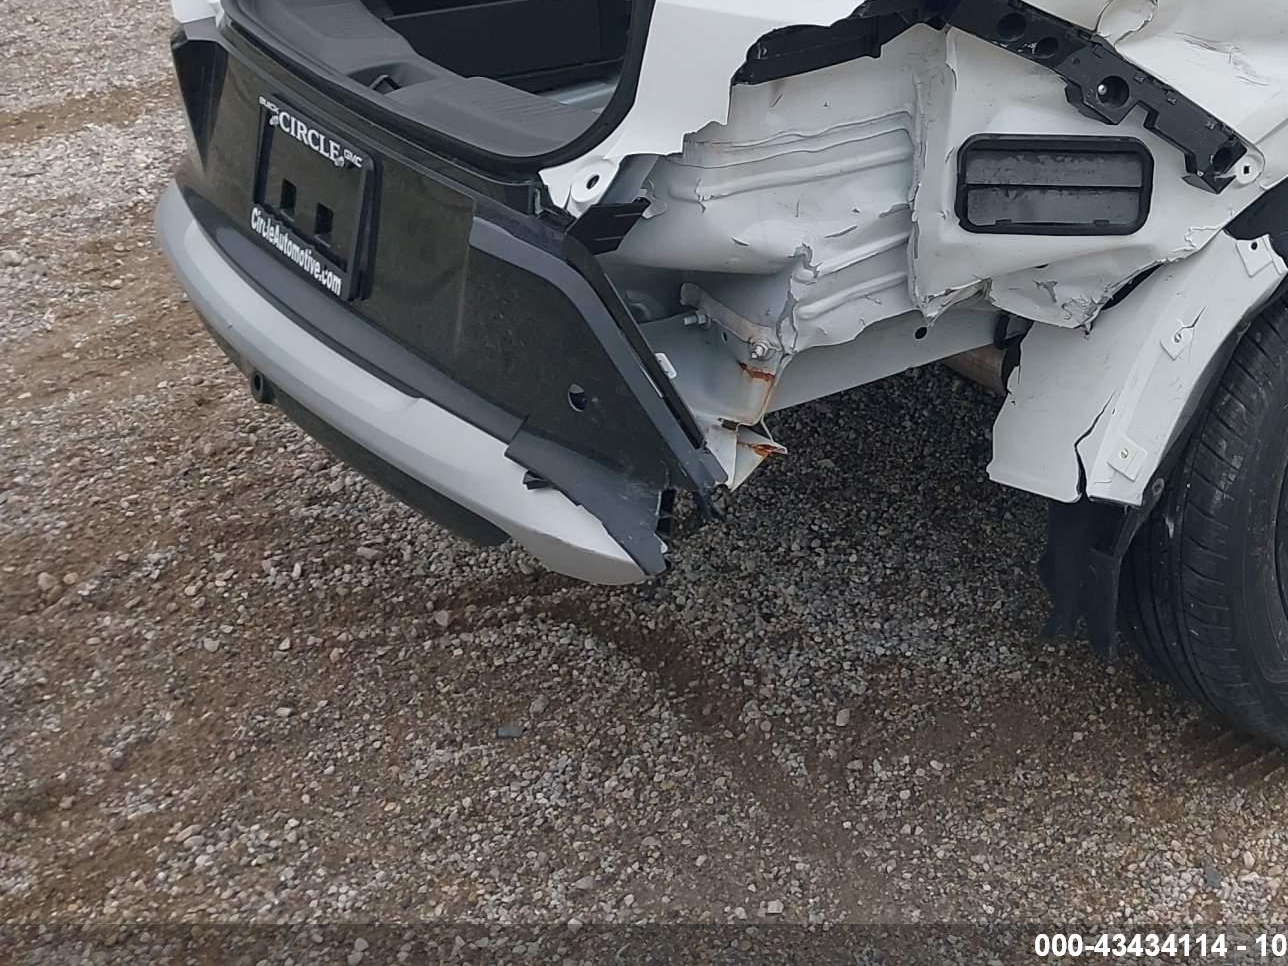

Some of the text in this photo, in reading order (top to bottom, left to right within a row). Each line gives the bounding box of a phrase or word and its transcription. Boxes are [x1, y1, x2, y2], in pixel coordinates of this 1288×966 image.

[279, 111, 340, 162] CIRCLE
[343, 149, 363, 168] GMC
[251, 207, 342, 296] CircleAutomotive.com
